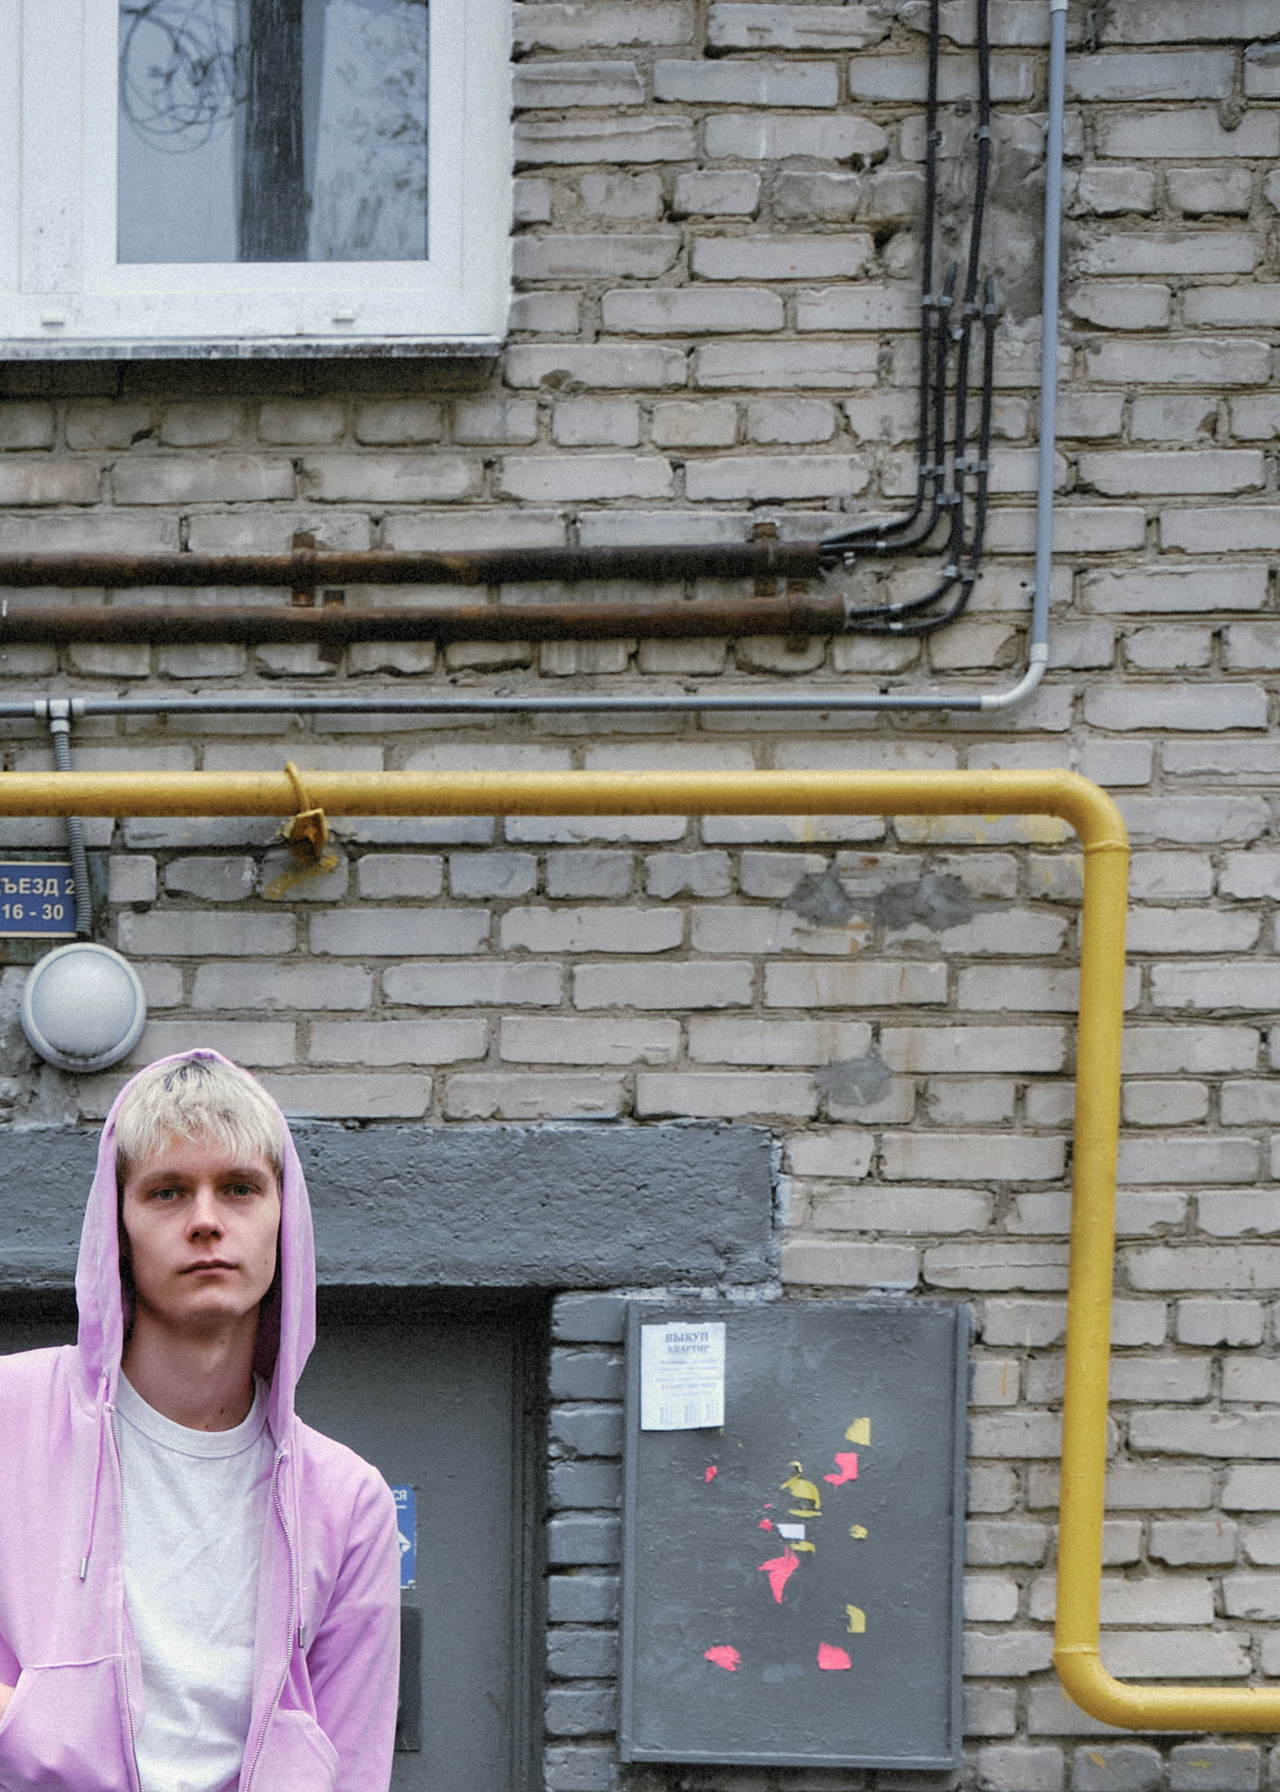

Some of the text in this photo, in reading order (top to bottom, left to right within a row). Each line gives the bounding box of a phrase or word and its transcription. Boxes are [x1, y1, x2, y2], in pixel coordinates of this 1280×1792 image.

[2, 903, 24, 919] 16
[42, 903, 64, 920] 30
[666, 1332, 709, 1343] ВЫКУП
